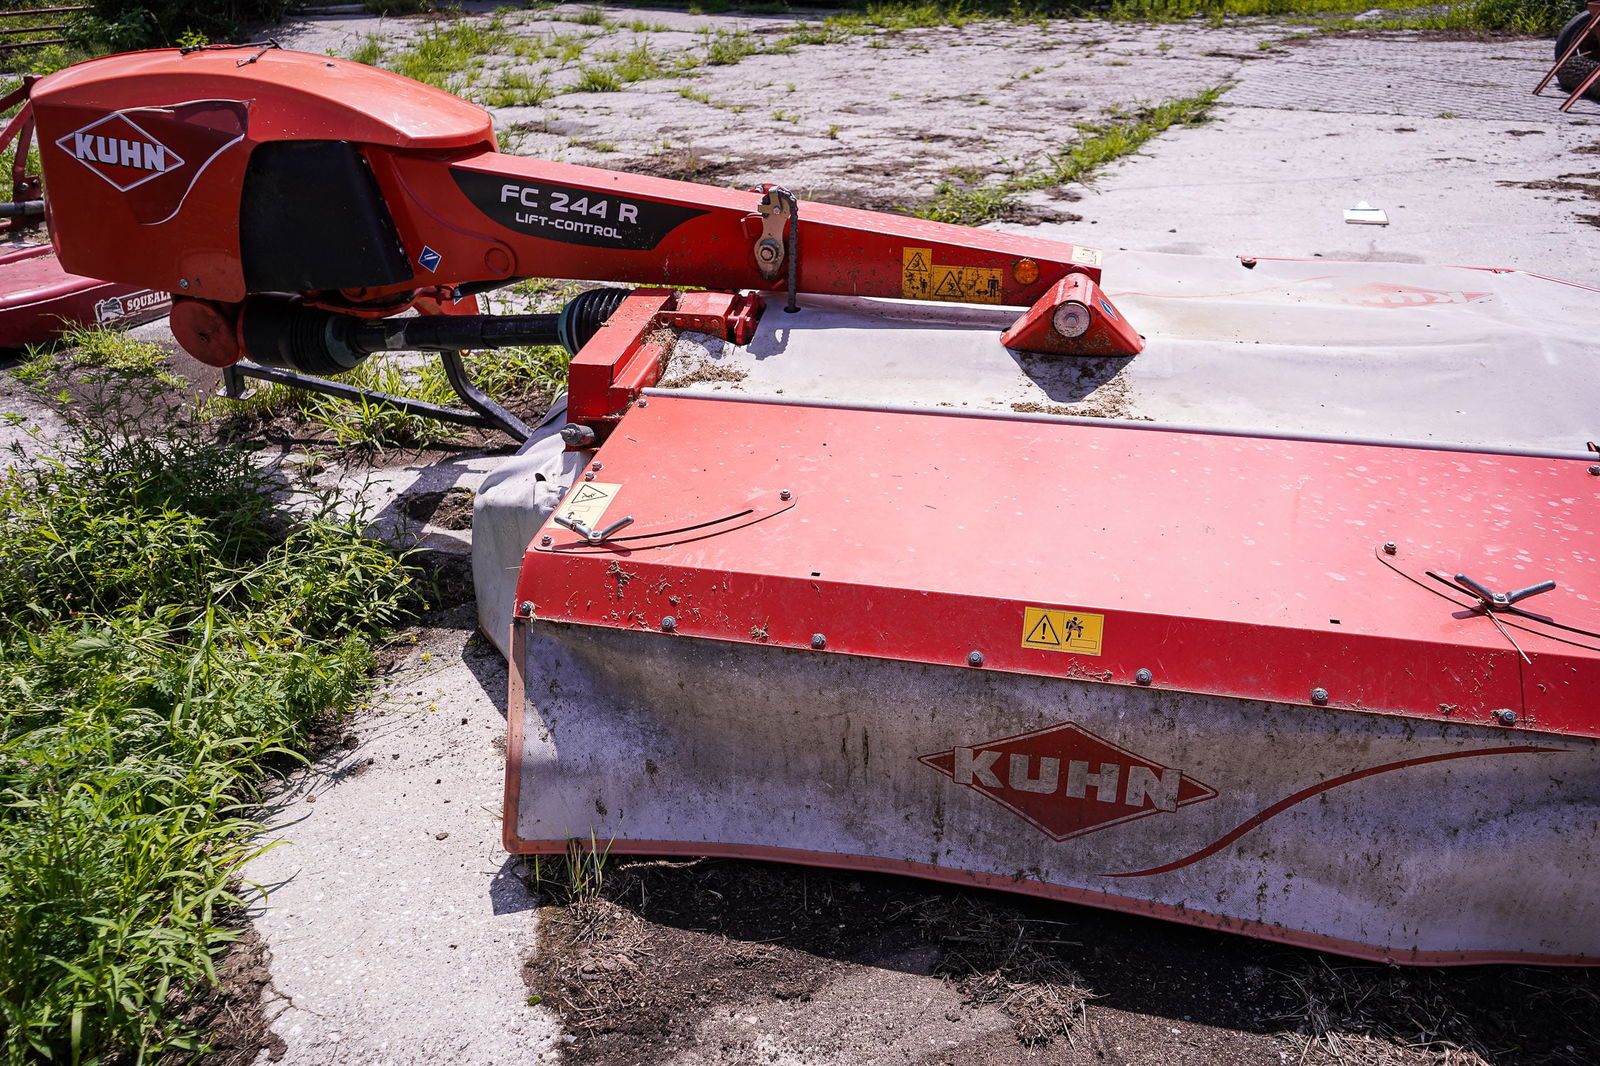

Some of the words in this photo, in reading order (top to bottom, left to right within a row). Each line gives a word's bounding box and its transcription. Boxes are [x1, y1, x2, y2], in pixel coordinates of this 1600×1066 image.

[74, 131, 166, 172] KUHN
[500, 184, 539, 208] FC
[550, 192, 608, 219] 244
[618, 203, 639, 224] R
[515, 212, 623, 239] LIFT-CONTROL
[953, 746, 1183, 813] KUHN
